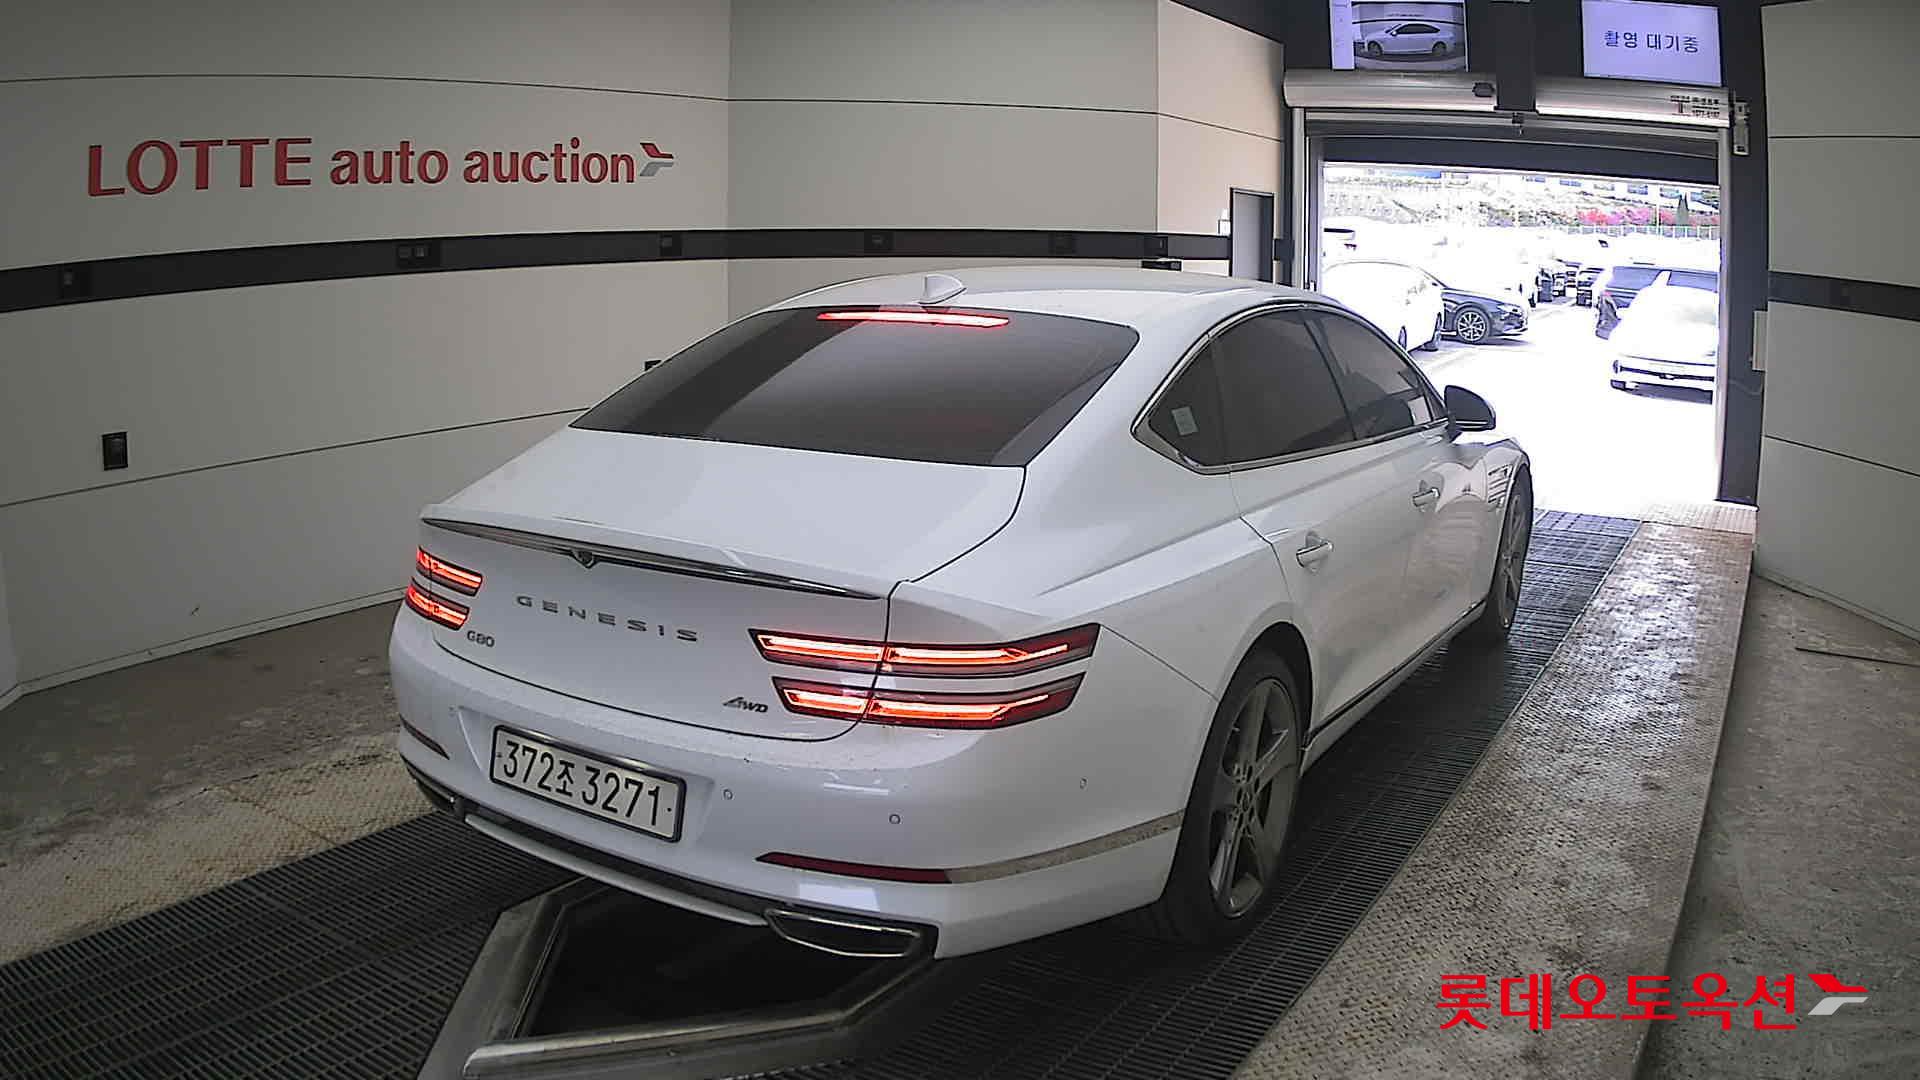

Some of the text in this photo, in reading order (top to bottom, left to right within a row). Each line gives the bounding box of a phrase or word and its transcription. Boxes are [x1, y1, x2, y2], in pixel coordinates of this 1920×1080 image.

[1604, 30, 1699, 54] 촬영 대기중
[88, 137, 635, 196] LOTTE auto auction
[517, 595, 700, 642] GENESIS
[466, 630, 496, 648] G80
[722, 695, 769, 713] AWD
[581, 757, 661, 827] 3271
